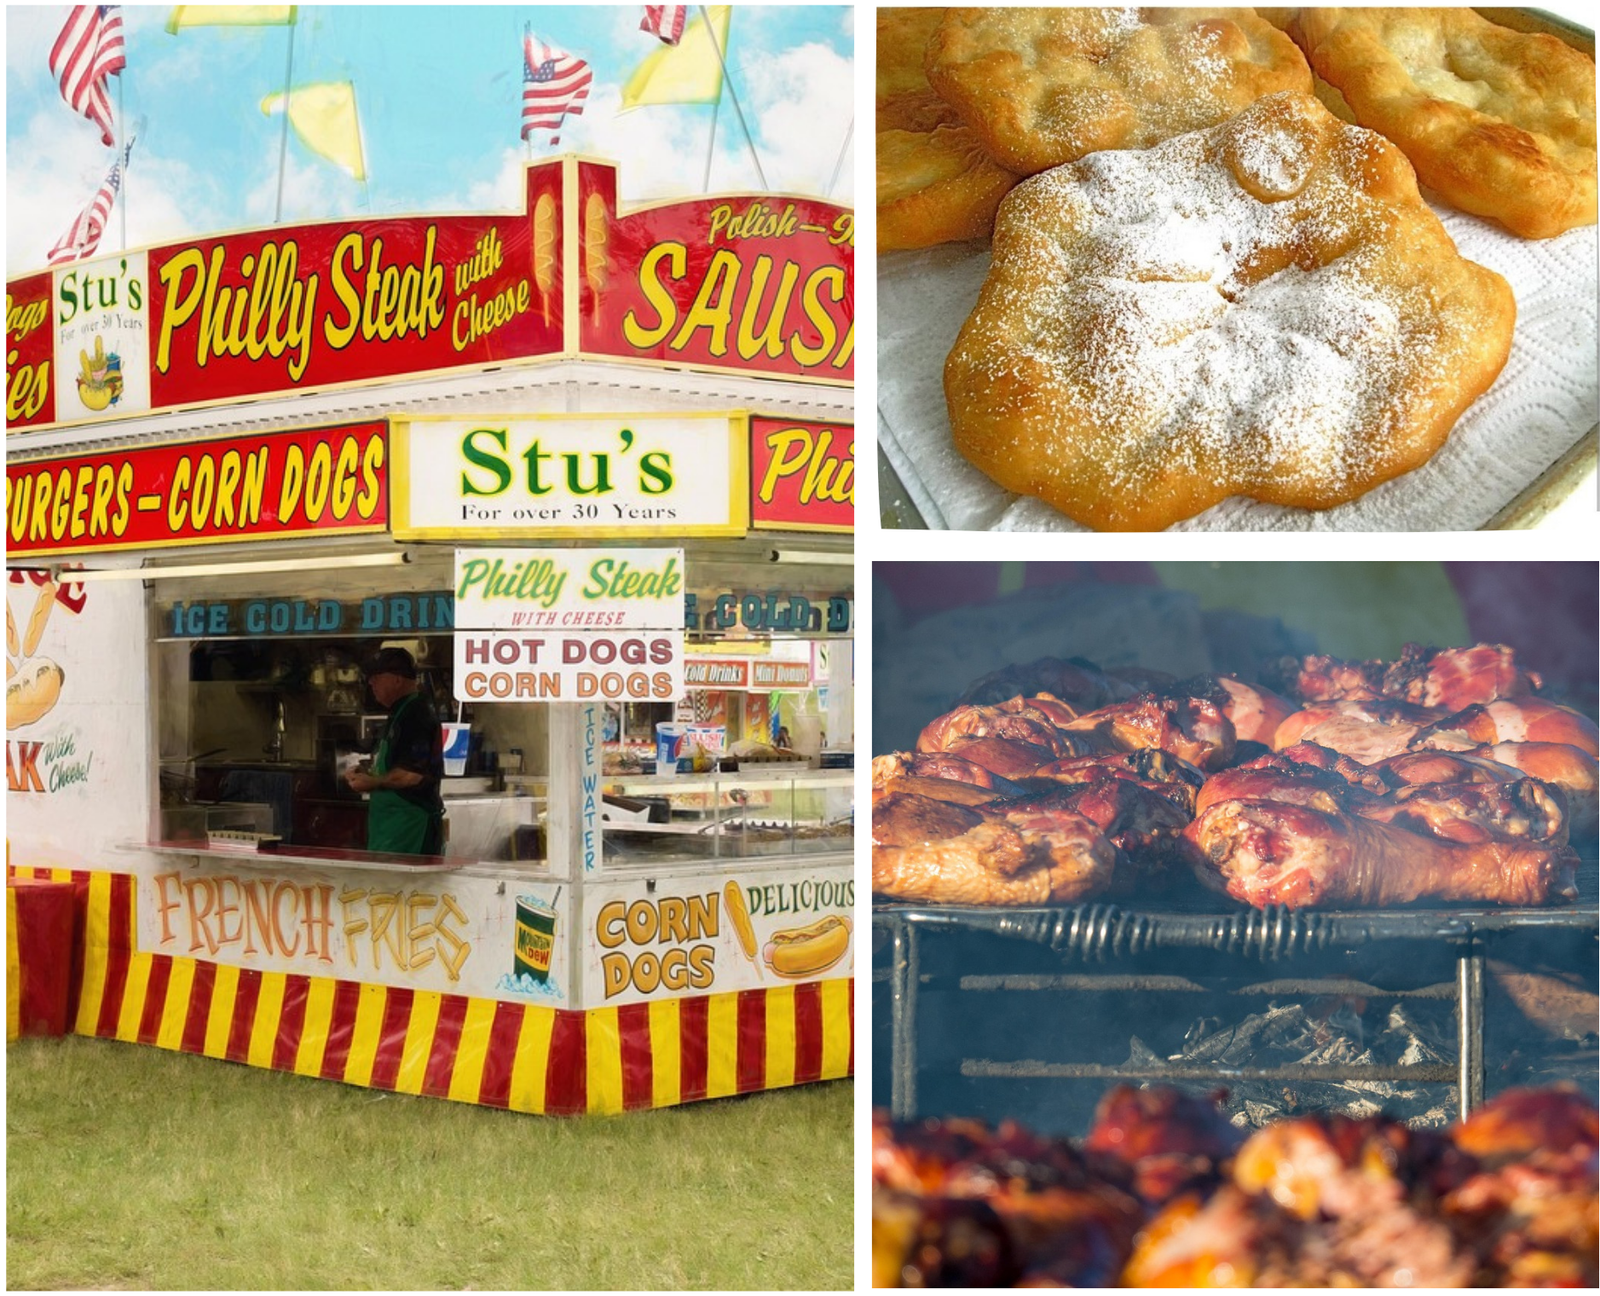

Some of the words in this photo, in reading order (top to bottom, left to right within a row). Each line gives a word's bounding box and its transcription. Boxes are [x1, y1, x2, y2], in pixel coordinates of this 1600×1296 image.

[708, 203, 797, 246] Polish
[59, 258, 143, 326] Stu's
[156, 240, 319, 382] Philly
[324, 224, 446, 348] Steak
[455, 226, 503, 296] with
[452, 279, 530, 351] Cheese
[622, 241, 854, 369] SAUS
[61, 328, 76, 344] For
[81, 321, 99, 334] over
[102, 314, 112, 330] 30
[116, 313, 143, 330] Years
[168, 445, 268, 533] CORN
[278, 433, 385, 524] DOGS
[461, 428, 674, 497] Stu's
[758, 427, 854, 507] Phi
[461, 503, 502, 520] For
[513, 506, 562, 520] over
[572, 503, 599, 520] 30
[613, 503, 678, 520] Years
[456, 556, 568, 609] Philly
[582, 556, 682, 601] Steak
[172, 602, 230, 635] ICE
[246, 600, 342, 633] COLD
[510, 611, 558, 627] WITH
[562, 611, 627, 627] CHEESE
[715, 593, 811, 629] COLD
[465, 638, 546, 665] HOT
[562, 638, 674, 665] DOGS
[709, 663, 743, 684] Drinks
[755, 664, 774, 684] Mini
[464, 671, 562, 699] CORN
[576, 671, 674, 699] DOGS
[584, 707, 595, 766] ICE
[583, 773, 597, 872] WATER
[154, 870, 335, 965] FRENCH
[338, 883, 472, 982] FRIES
[596, 892, 720, 948] CORN
[601, 944, 715, 999] DOGS
